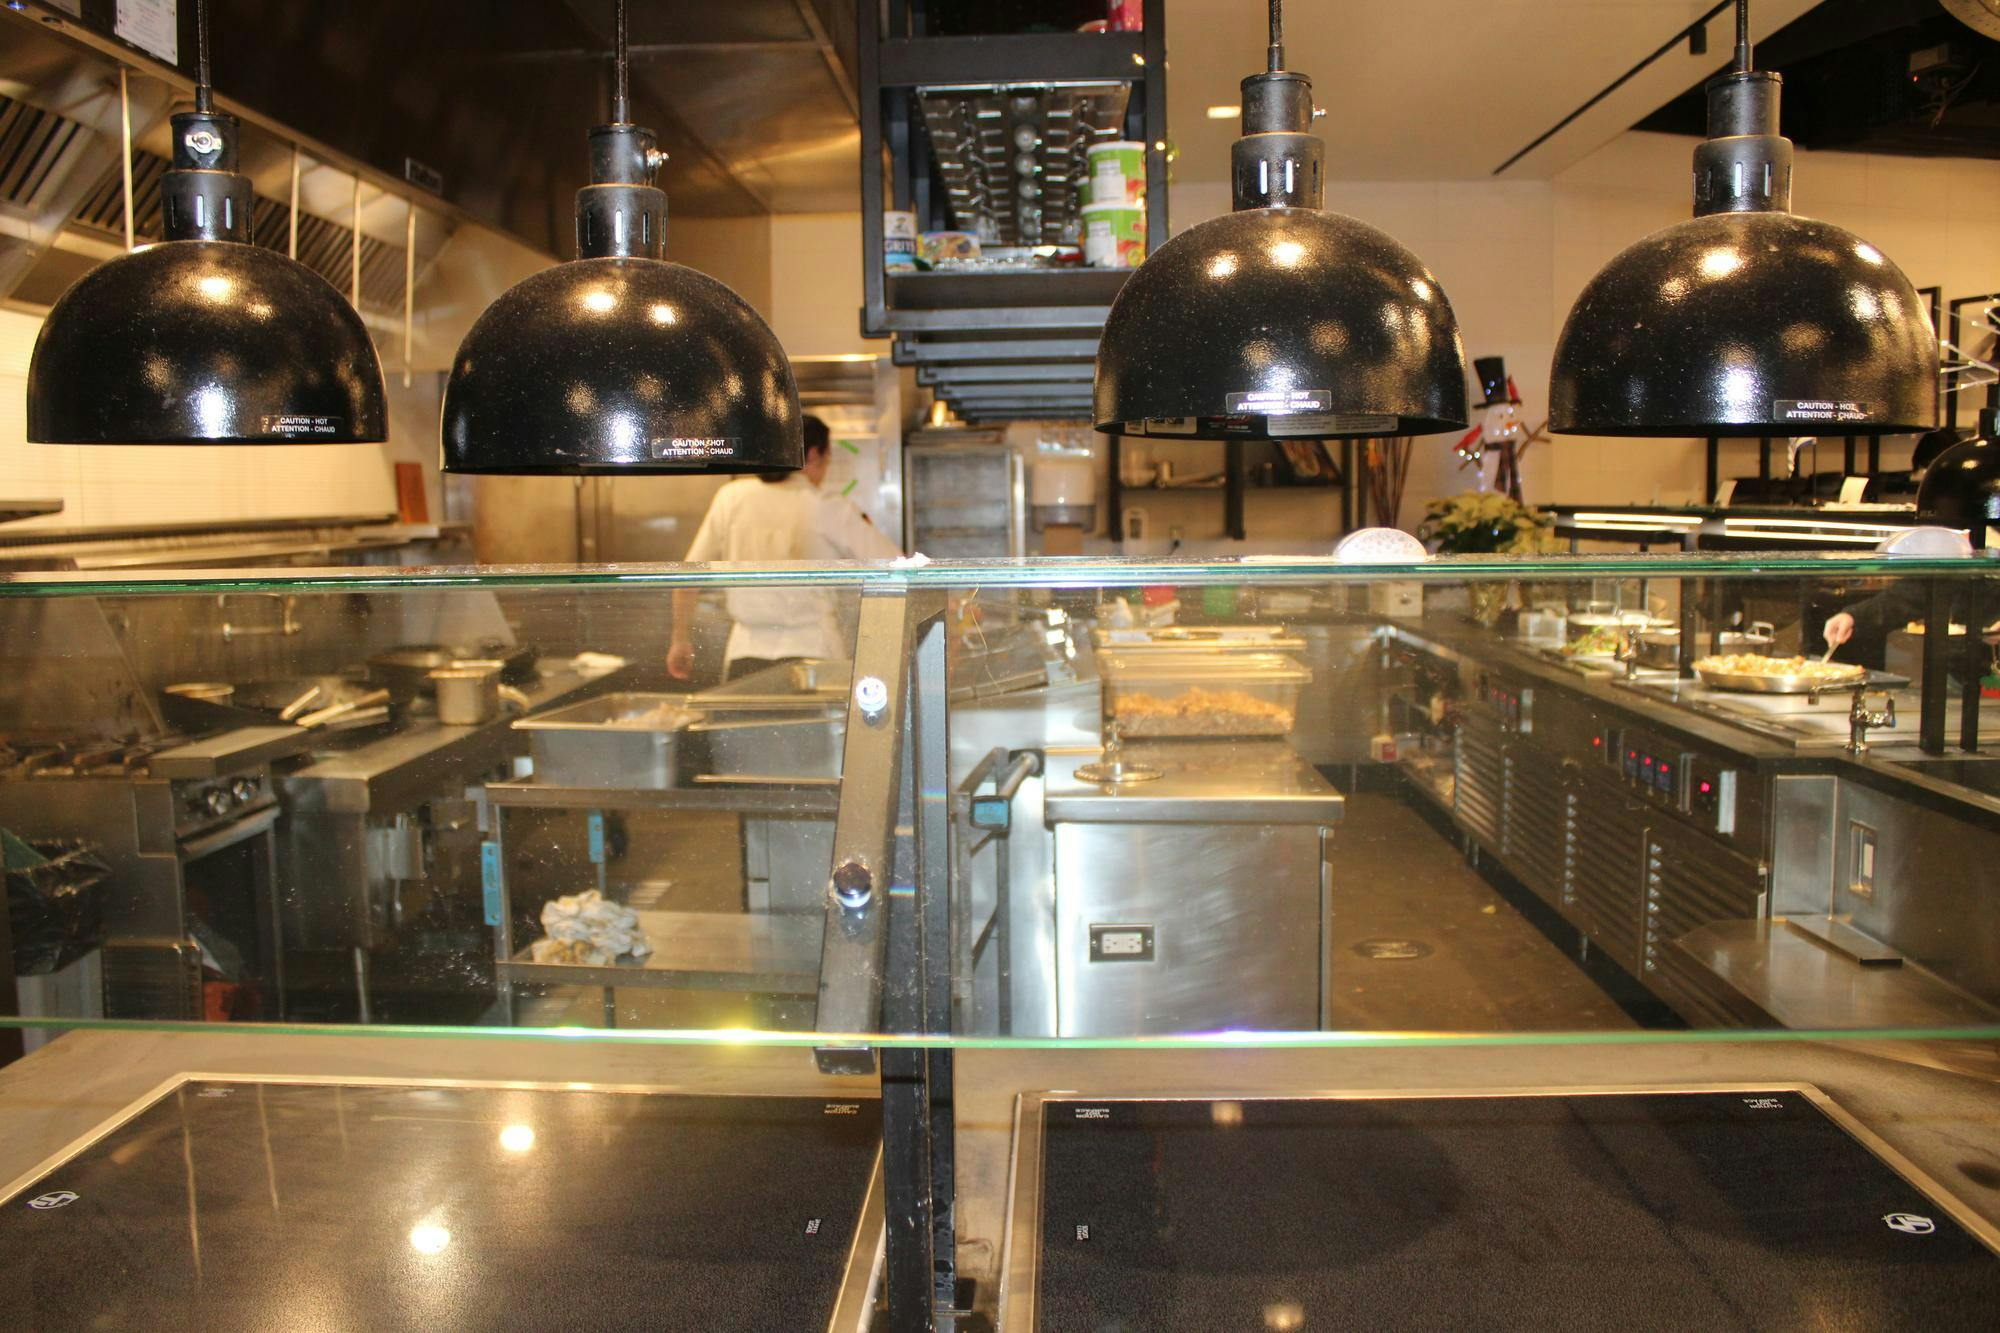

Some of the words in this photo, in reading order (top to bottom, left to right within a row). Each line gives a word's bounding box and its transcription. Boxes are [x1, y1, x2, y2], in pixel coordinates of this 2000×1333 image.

[1291, 391, 1309, 400] HOT
[1290, 400, 1320, 409] CHAUD
[1797, 402, 1833, 410] CAUTION
[1840, 403, 1856, 411] HOT
[1786, 411, 1832, 419] ATTENTION
[1839, 411, 1865, 420] CHAUD
[280, 417, 310, 425] CAUTION
[271, 425, 310, 433] ATTENTION
[672, 439, 705, 447] CAUTION
[710, 439, 725, 447] HOT
[662, 448, 705, 456] ATTENTION
[709, 447, 734, 455] CHAUD
